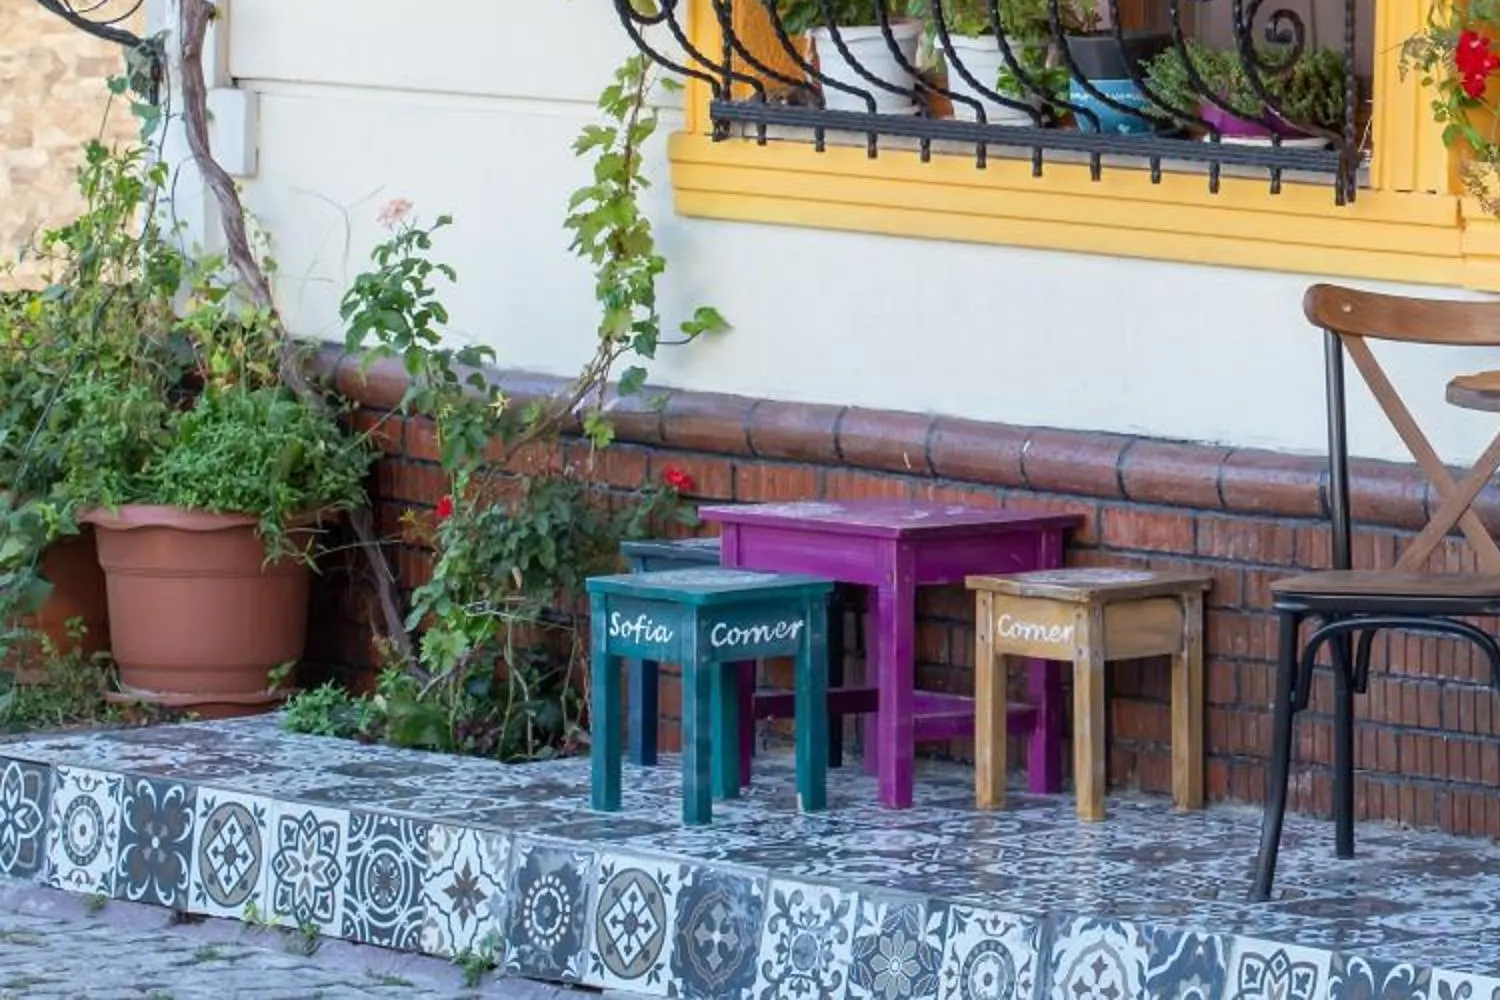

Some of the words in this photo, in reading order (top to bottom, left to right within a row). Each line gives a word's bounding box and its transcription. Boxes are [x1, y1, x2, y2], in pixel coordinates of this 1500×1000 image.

[609, 612, 674, 644] Sofia
[711, 620, 804, 648] Corner
[998, 613, 1074, 643] Corner
